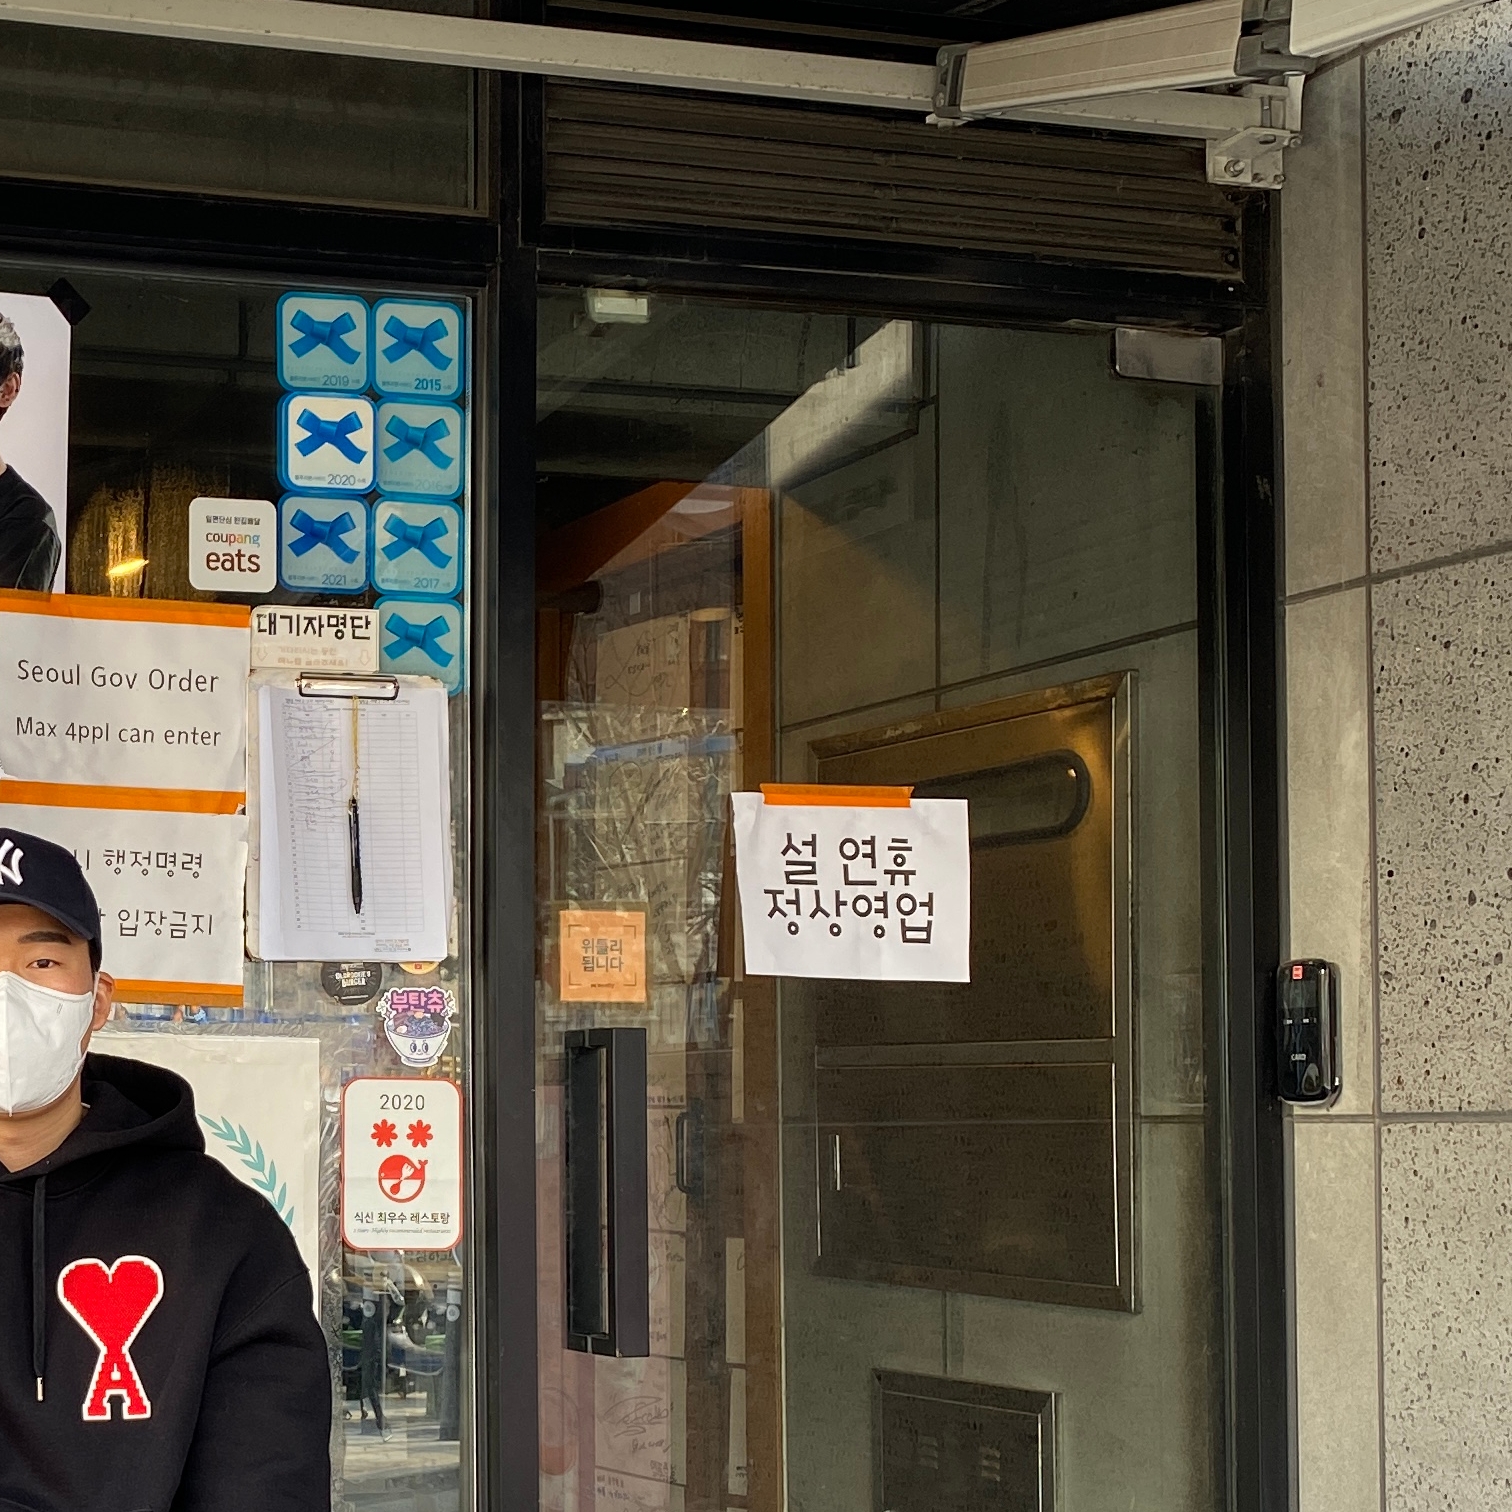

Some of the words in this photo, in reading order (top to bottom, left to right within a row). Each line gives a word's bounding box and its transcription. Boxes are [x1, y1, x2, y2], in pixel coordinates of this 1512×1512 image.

[322, 375, 349, 387] 2019
[414, 378, 441, 391] 2015
[327, 474, 356, 486] 2020
[206, 532, 260, 548] coupang
[206, 549, 261, 573] eats
[322, 574, 346, 586] 2021
[413, 577, 440, 589] 2017
[256, 613, 371, 640] 대기자명단
[17, 659, 81, 686] Seoul
[91, 666, 138, 690] Gov
[148, 668, 219, 693] Order
[16, 716, 57, 737] Max
[65, 722, 109, 744] 4ppl
[118, 727, 155, 743] can
[164, 726, 222, 747] enter
[103, 849, 203, 879] 행정명령
[781, 833, 818, 885] 설
[839, 835, 916, 886] 연휴
[118, 908, 213, 939] 입장금지
[763, 889, 934, 944] 정상영업
[581, 956, 625, 973] 됩니다
[392, 989, 444, 1013] 부탄츄
[379, 1094, 426, 1111] 2020
[354, 1212, 374, 1224] 식신
[377, 1212, 407, 1224] 최우수
[410, 1212, 450, 1224] 레스토랑
